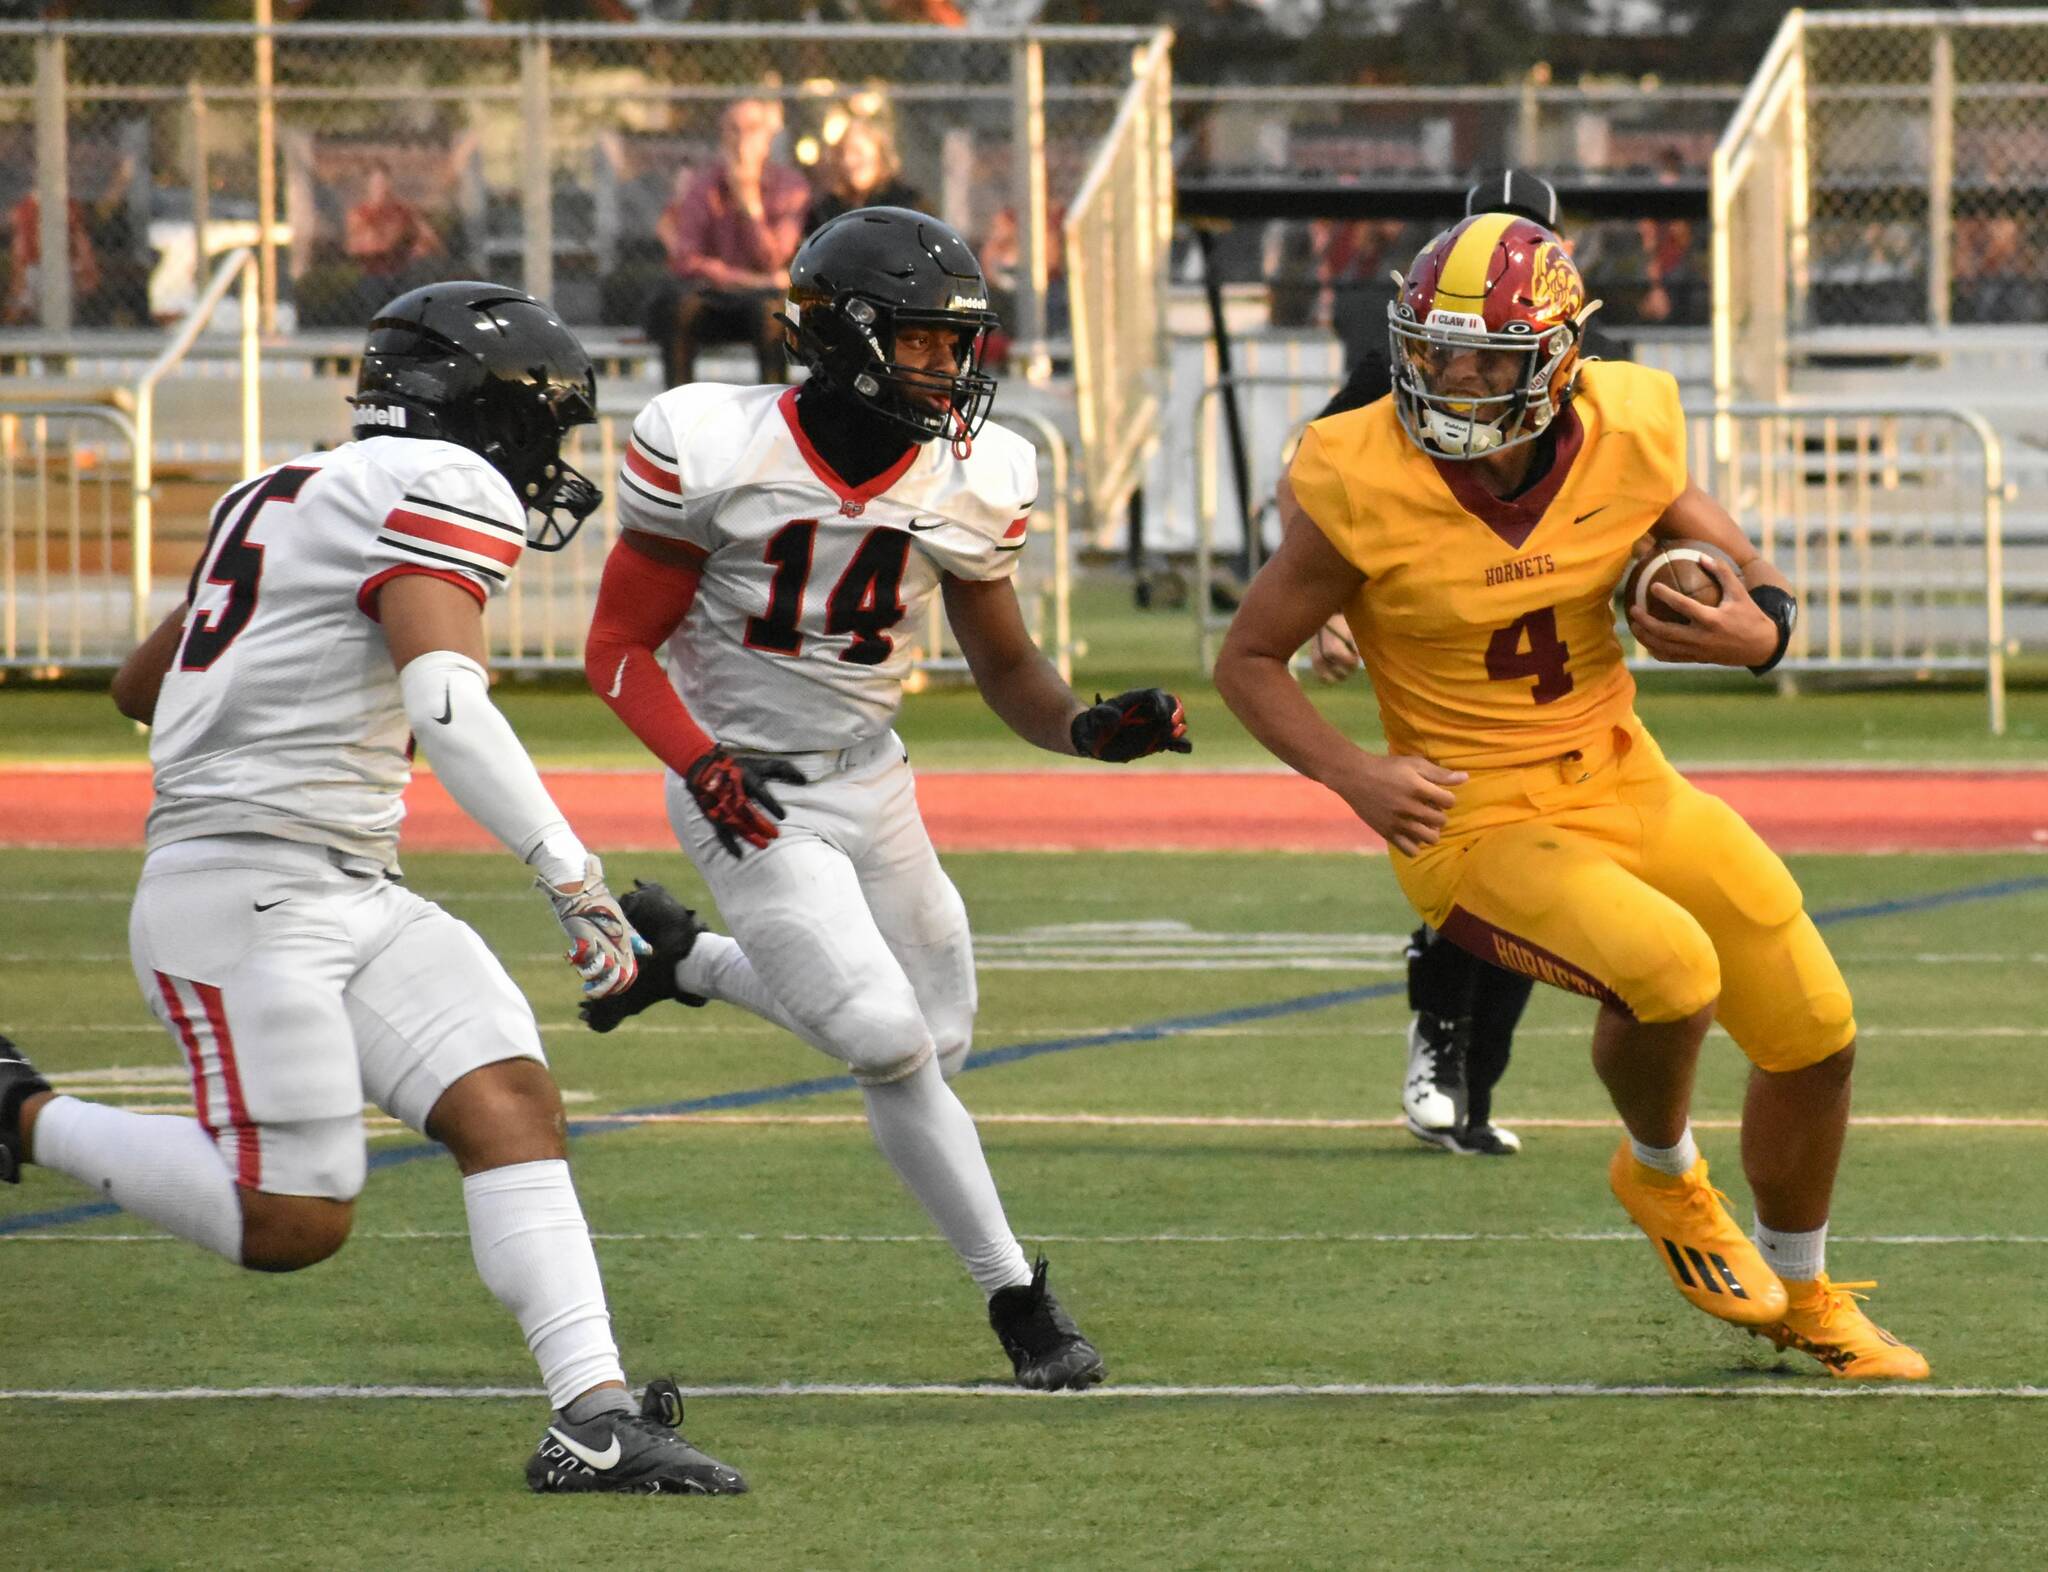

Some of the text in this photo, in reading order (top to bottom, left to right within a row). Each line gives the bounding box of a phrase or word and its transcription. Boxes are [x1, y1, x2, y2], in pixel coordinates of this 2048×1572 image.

[1438, 314, 1467, 327] CLAW
[743, 518, 913, 666] 14
[1484, 553, 1556, 587] HORNETS
[1484, 604, 1575, 706] 4
